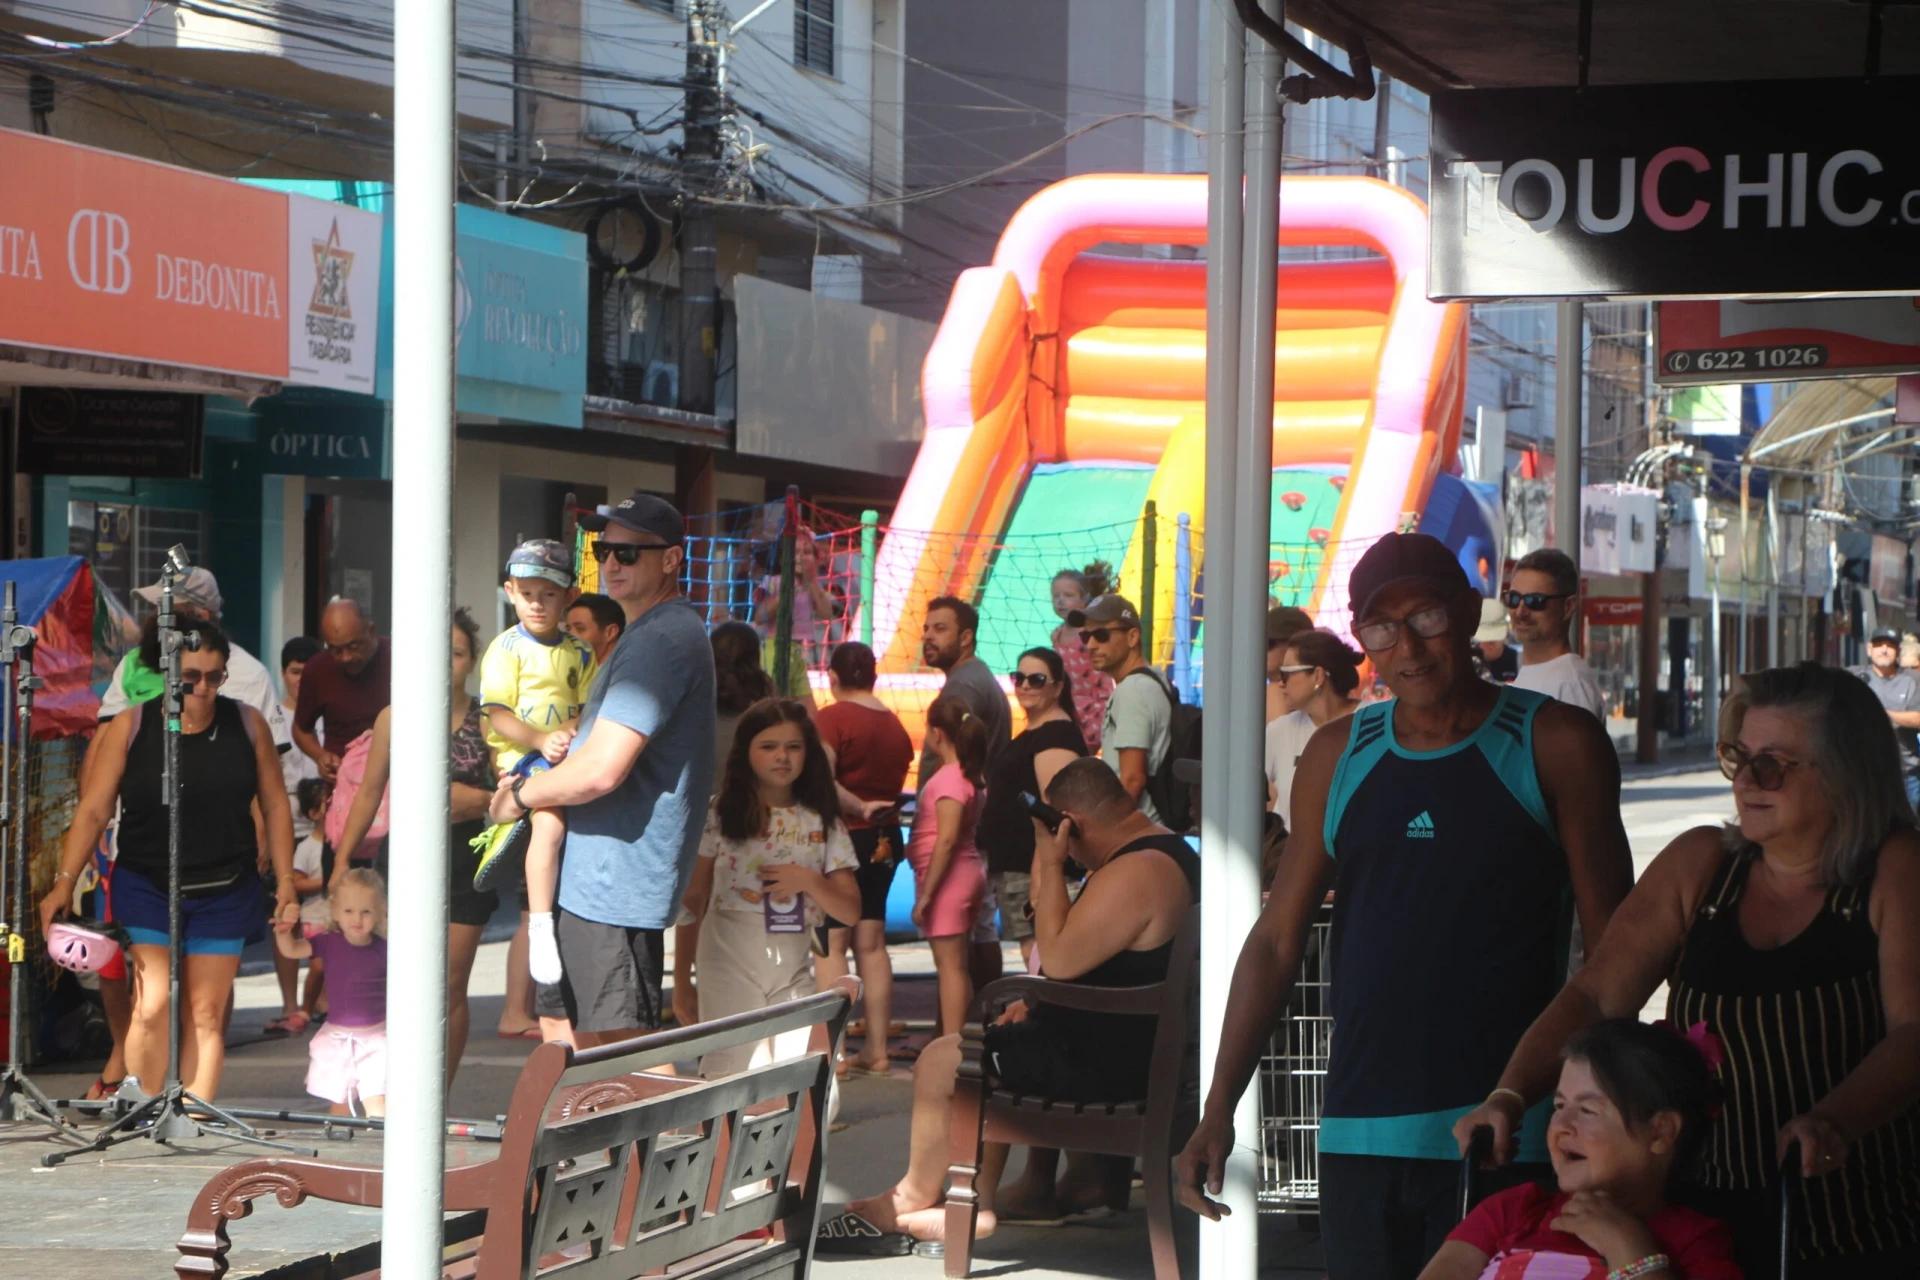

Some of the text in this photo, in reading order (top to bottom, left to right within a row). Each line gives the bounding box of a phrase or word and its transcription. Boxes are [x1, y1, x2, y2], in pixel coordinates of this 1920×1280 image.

[156, 253, 281, 320] DEBONITA
[1697, 348, 1820, 370] 622 1026
[1407, 827, 1435, 839] adidas
